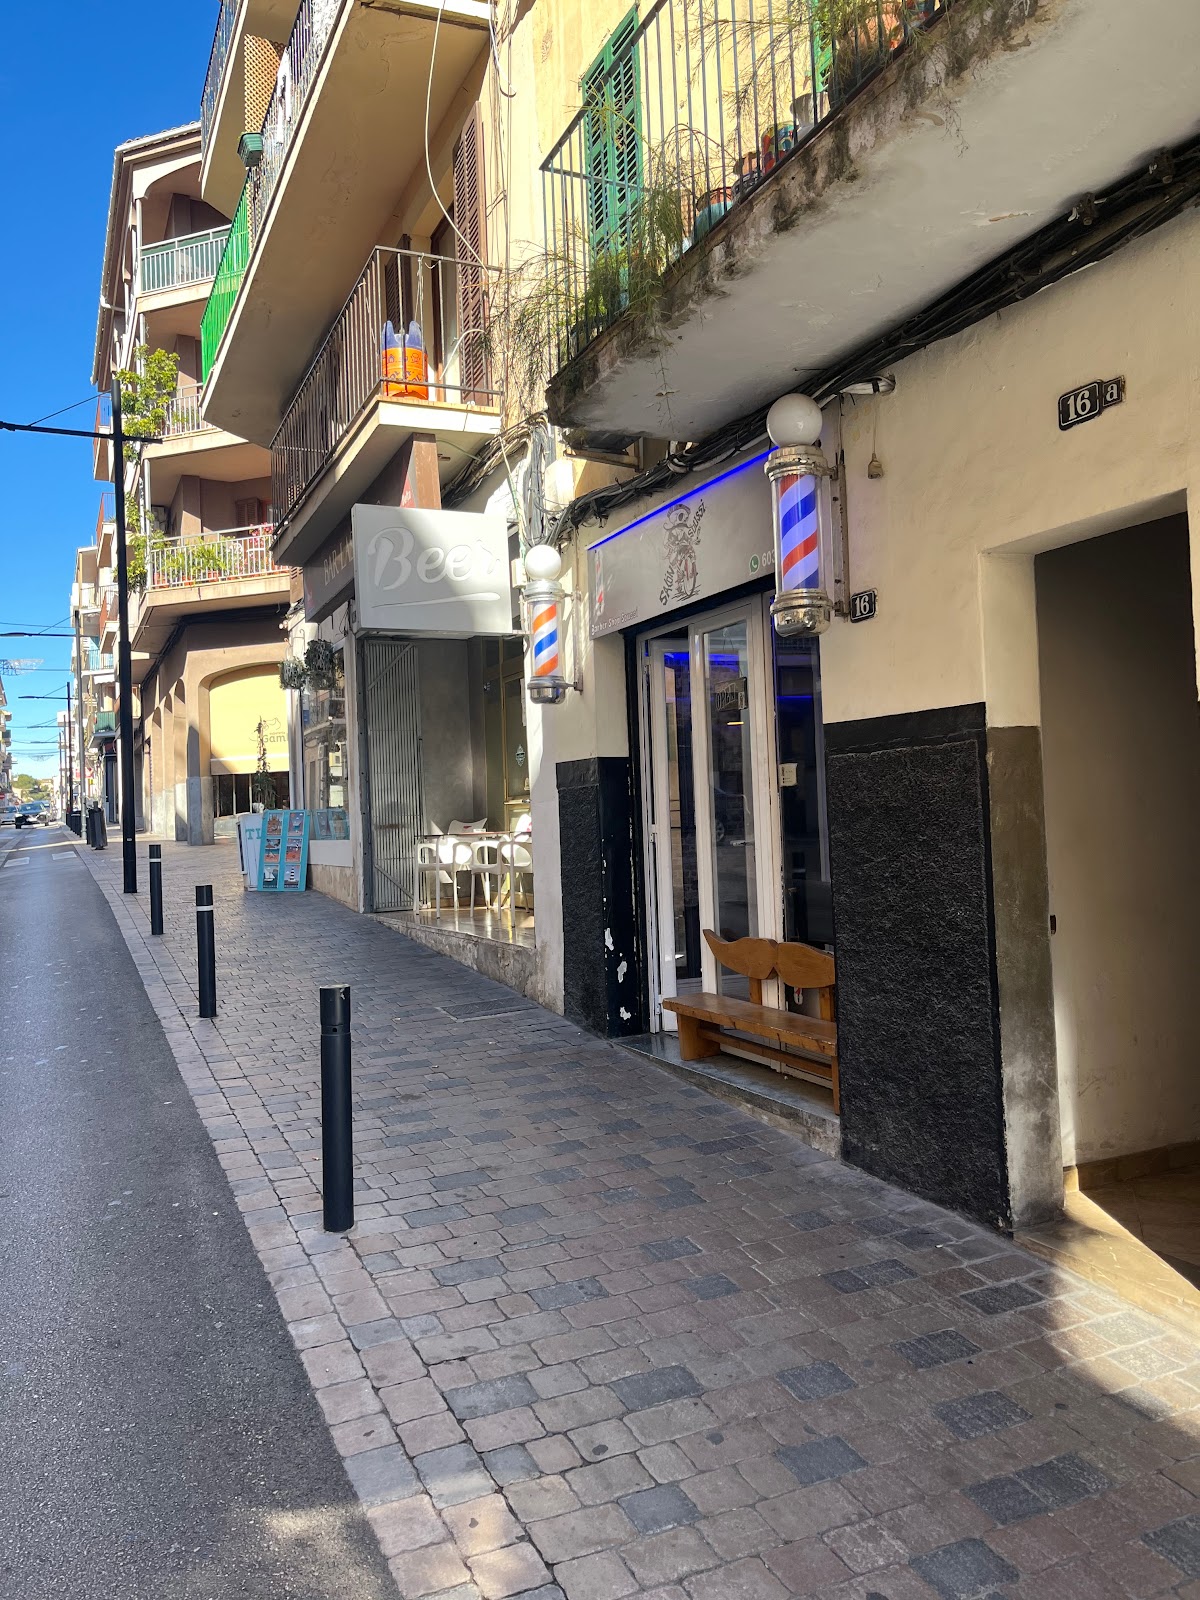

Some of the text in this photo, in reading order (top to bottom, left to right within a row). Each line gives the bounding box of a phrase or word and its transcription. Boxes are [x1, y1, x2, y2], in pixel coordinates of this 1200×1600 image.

[1066, 380, 1119, 421] 16 a
[323, 549, 340, 587] BAR
[854, 596, 870, 616] 16
